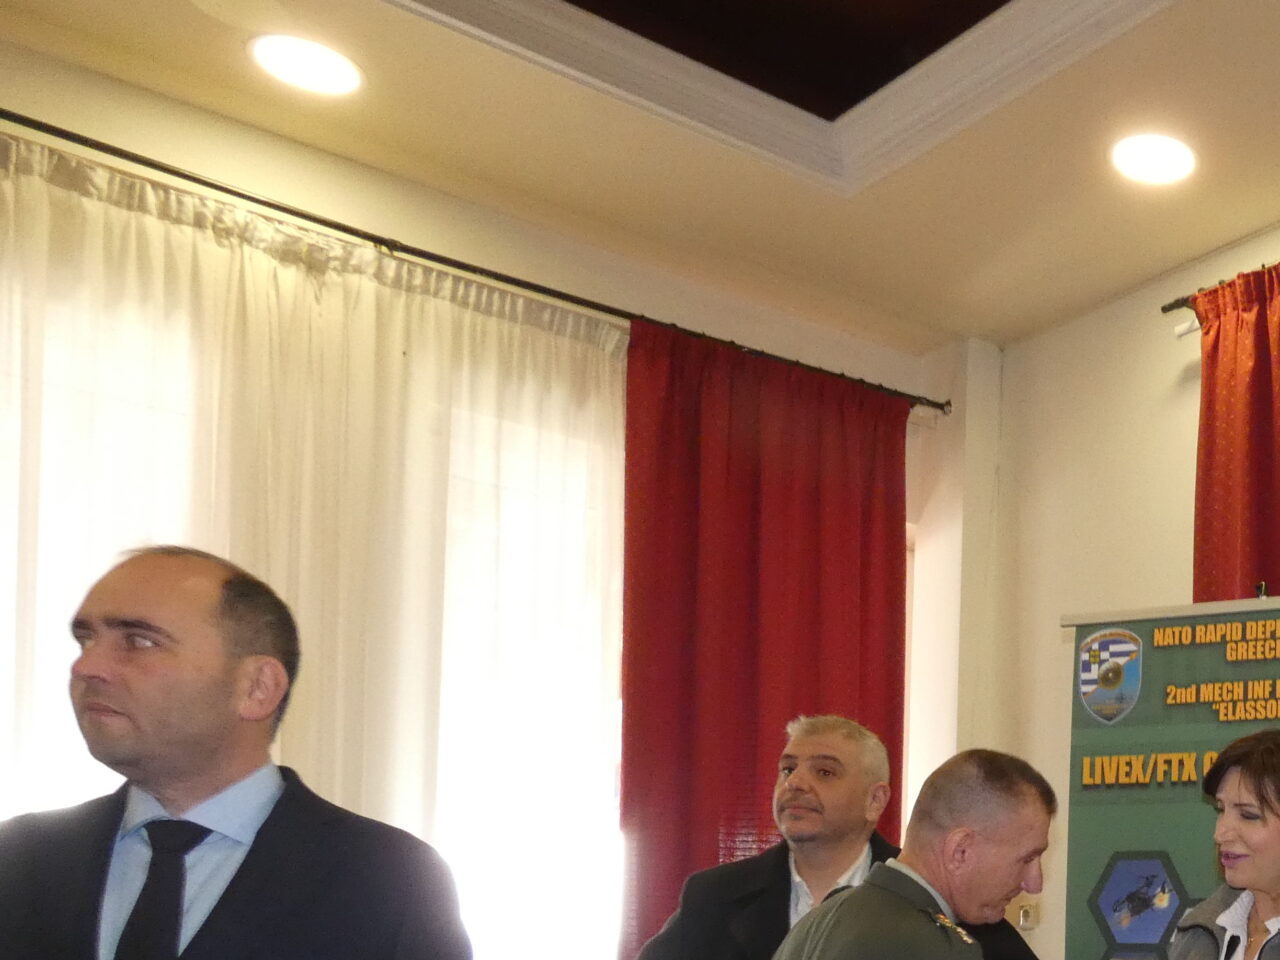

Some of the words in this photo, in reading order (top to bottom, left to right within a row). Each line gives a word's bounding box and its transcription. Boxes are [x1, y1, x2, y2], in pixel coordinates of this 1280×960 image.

[1154, 626, 1192, 647] NATO
[1196, 622, 1242, 643] RAPID
[1166, 684, 1197, 705] 2nd
[1200, 681, 1244, 702] MECH
[1247, 680, 1273, 700] INF
[1082, 752, 1198, 785] LIVEX/FTX
